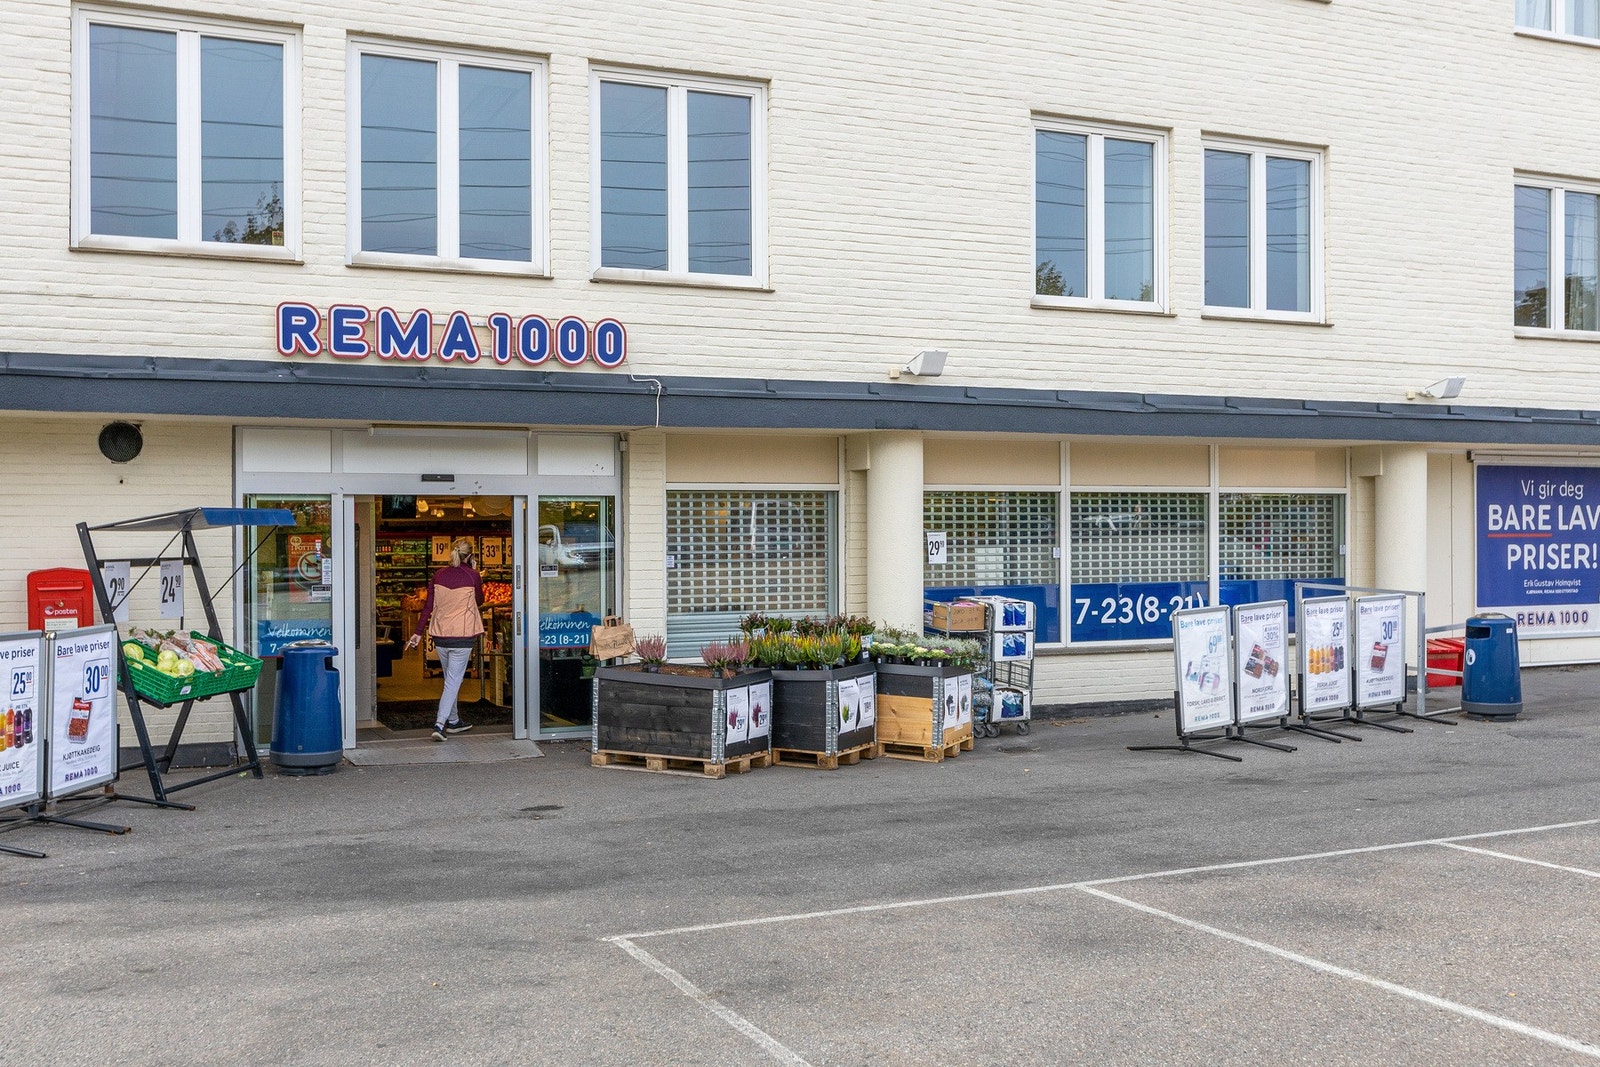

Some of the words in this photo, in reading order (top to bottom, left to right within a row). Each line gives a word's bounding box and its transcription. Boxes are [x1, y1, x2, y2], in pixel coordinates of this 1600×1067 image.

[276, 302, 481, 363] REMA
[487, 312, 627, 369] 1000
[1521, 480, 1534, 496] Vi
[1538, 480, 1555, 499] gir
[1559, 480, 1584, 500] deg
[1488, 504, 1551, 531] BARE
[1558, 504, 1600, 531] LAV
[1507, 543, 1597, 571] PRISER!
[1524, 580, 1533, 588] Erik
[1555, 579, 1581, 588] Holmqvist
[1306, 608, 1318, 616] Bare
[1329, 605, 1344, 614] priser
[1360, 606, 1372, 614] Bare
[1384, 604, 1400, 613] priser
[1180, 620, 1193, 629] Bare
[1194, 618, 1206, 626] lave
[1241, 614, 1253, 623] Bare
[1254, 613, 1265, 621] lave
[1266, 611, 1281, 621] priser
[1517, 612, 1556, 626] REMA
[1560, 611, 1589, 625] 1000
[540, 617, 590, 631] elkommen
[267, 623, 332, 639] Velkommen
[540, 635, 557, 645] -23
[559, 634, 589, 645] (8-21)
[11, 647, 35, 660] priser
[57, 645, 73, 656] Bare
[74, 643, 88, 654] lave
[90, 640, 110, 652] priser
[1250, 704, 1265, 713] REMA
[3, 761, 20, 772] JUICE
[65, 770, 83, 782] REMA
[84, 766, 98, 778] 1000
[5, 783, 21, 794] 1000
